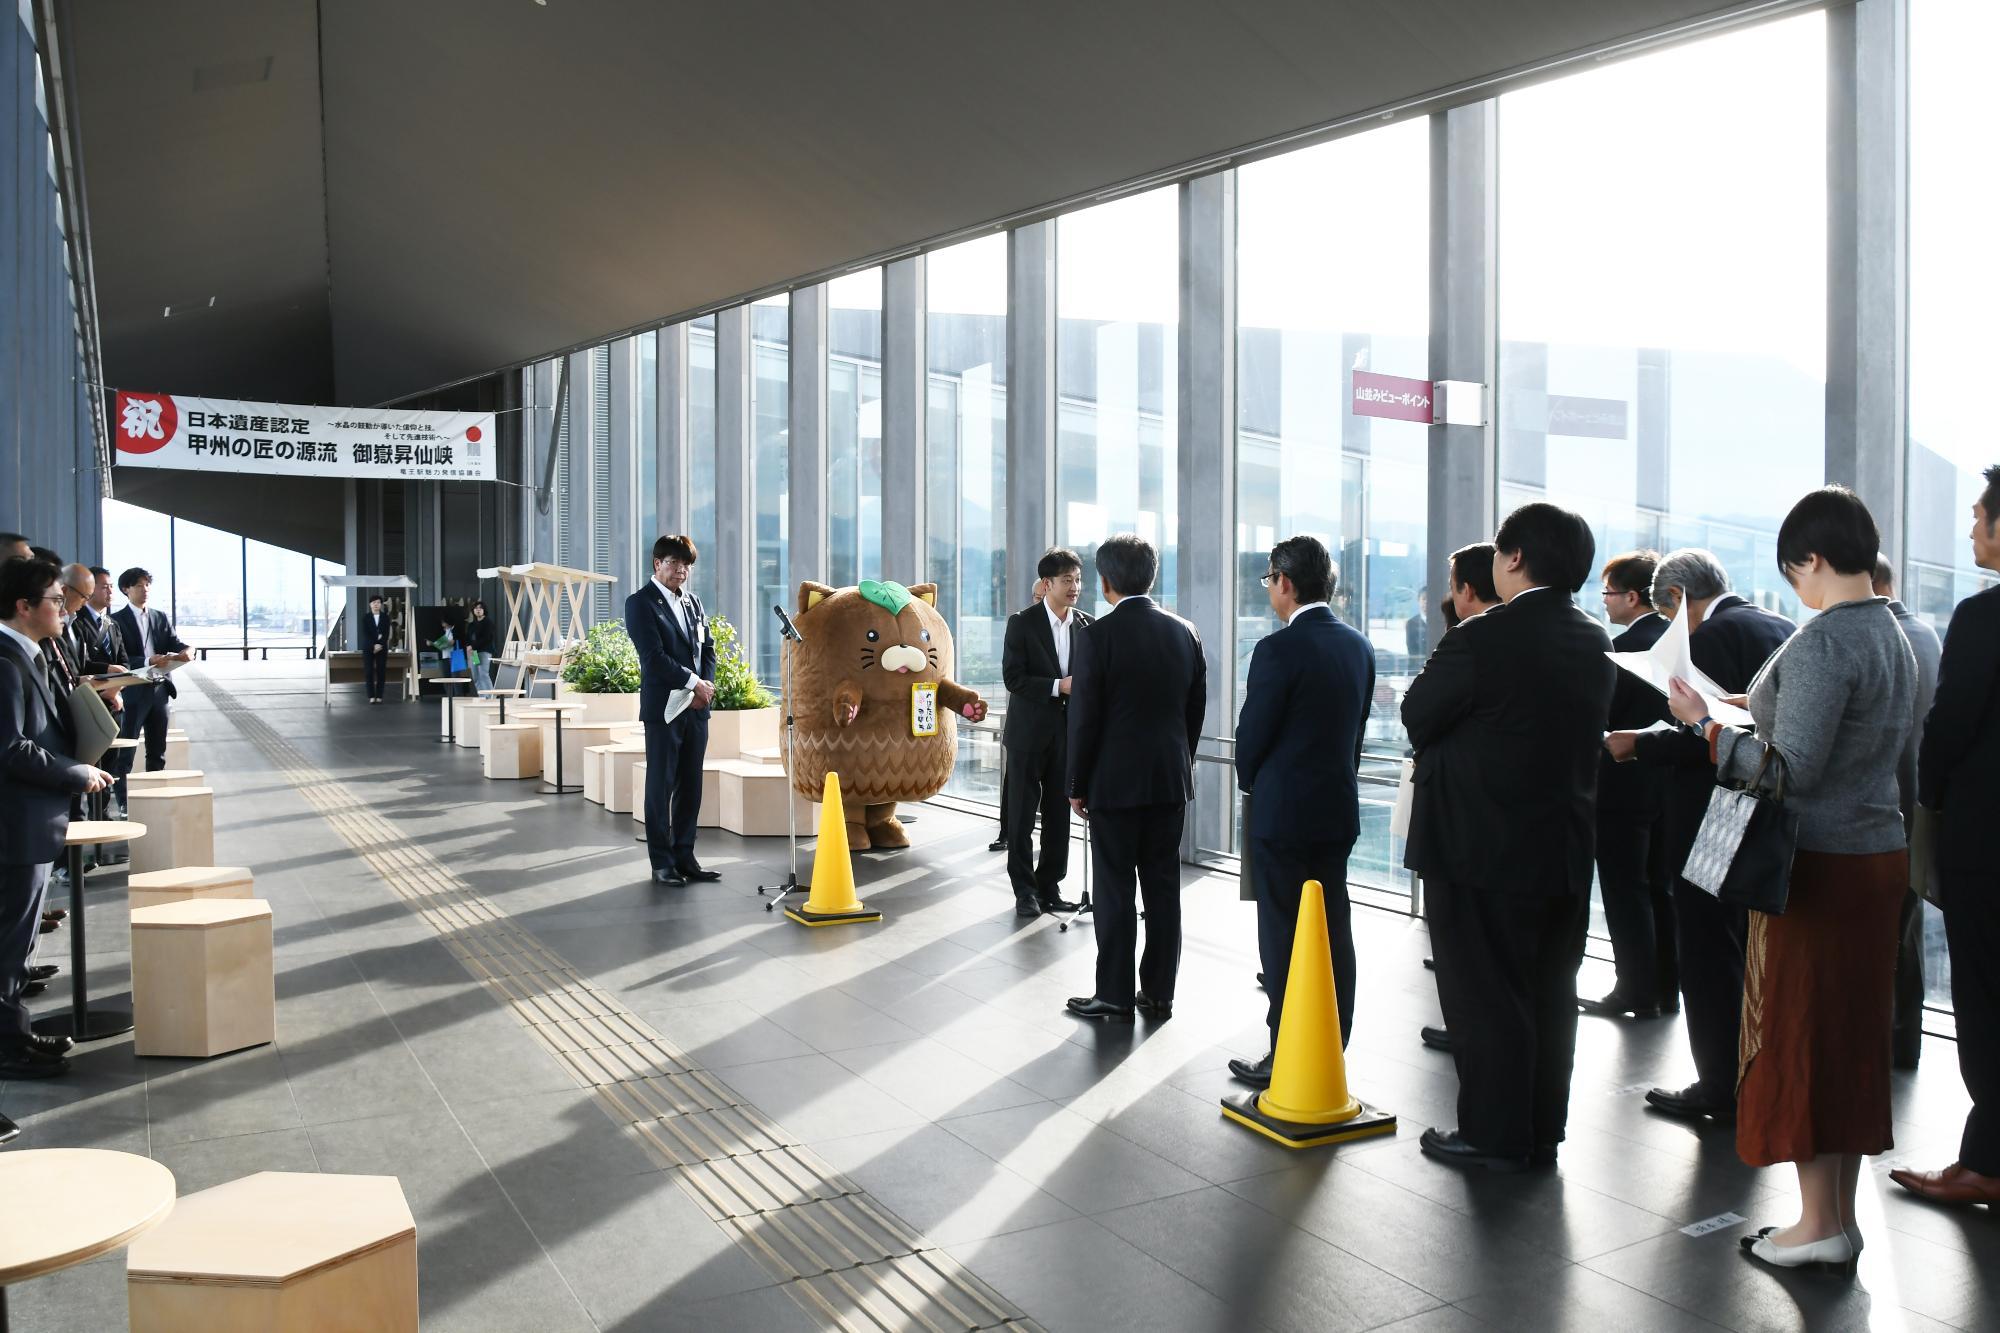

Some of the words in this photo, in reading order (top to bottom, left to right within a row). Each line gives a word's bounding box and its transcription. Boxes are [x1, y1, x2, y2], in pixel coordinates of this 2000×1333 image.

[1355, 387, 1431, 409] 山並みビューポイント
[121, 396, 165, 439] 祝
[187, 411, 311, 434] 日本遺産認定
[187, 434, 337, 463] 甲州の匠の源流
[353, 443, 454, 465] 御嶽昇仙峡
